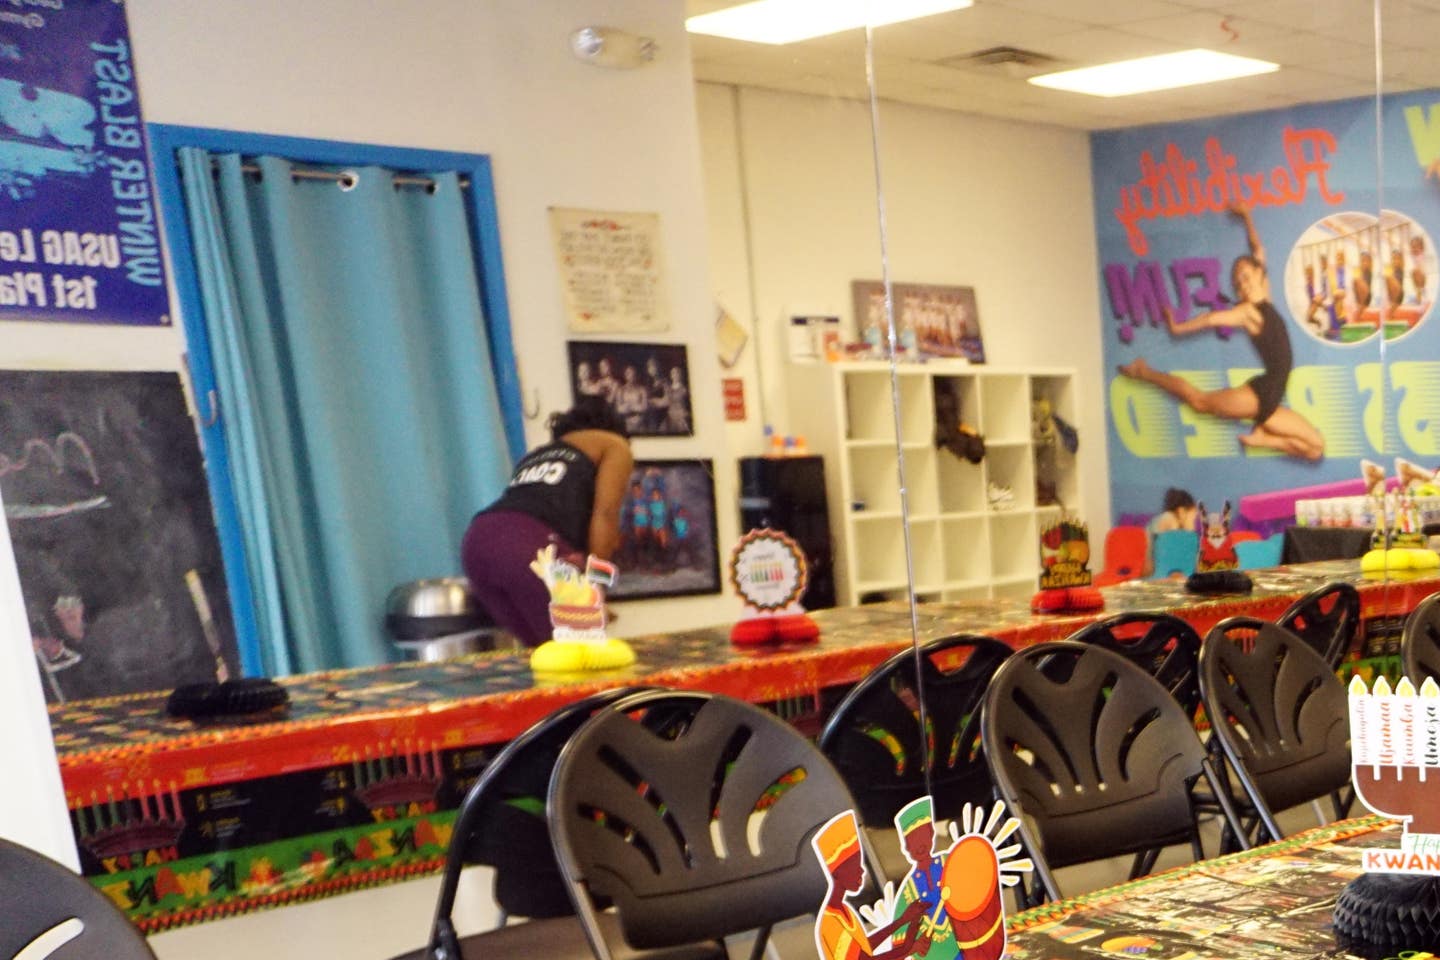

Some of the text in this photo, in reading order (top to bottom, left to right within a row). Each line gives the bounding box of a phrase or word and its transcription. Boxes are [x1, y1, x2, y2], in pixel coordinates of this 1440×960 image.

[1379, 702, 1395, 764] Ujamaa
[1400, 704, 1416, 765] Kuumba
[1424, 706, 1440, 765] Umoja
